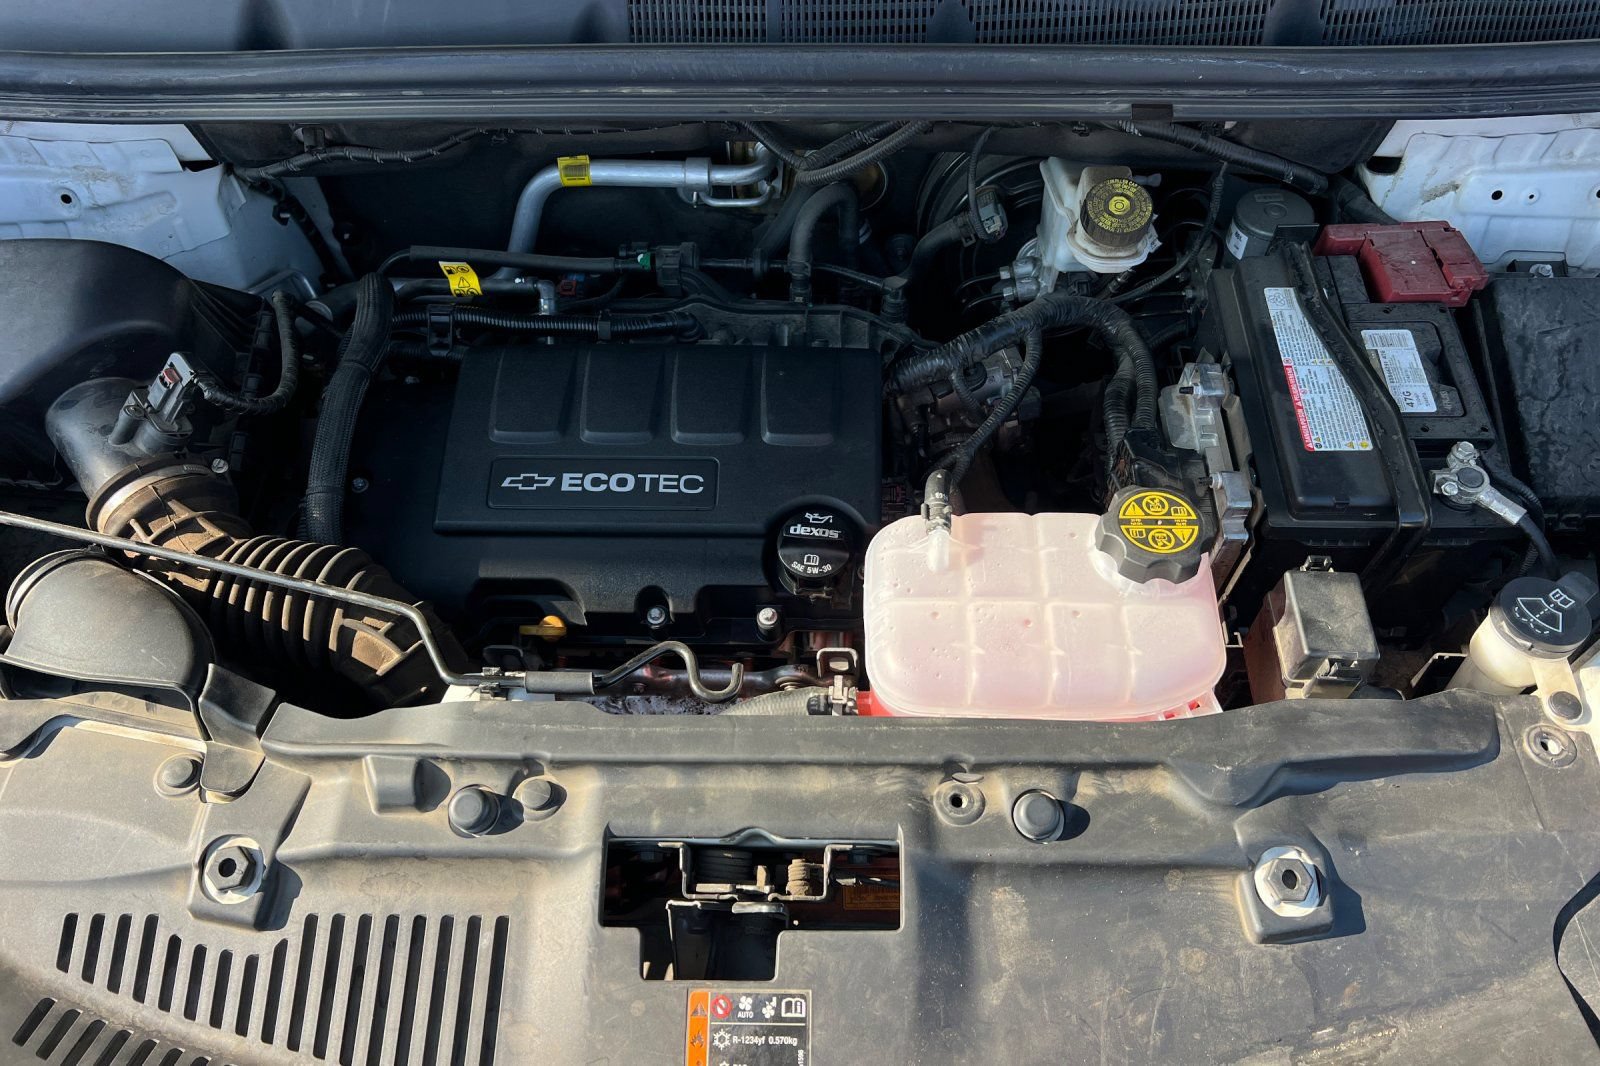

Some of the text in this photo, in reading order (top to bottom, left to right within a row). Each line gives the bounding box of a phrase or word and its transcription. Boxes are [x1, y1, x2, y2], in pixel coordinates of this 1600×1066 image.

[1402, 391, 1415, 408] 47G
[560, 472, 705, 494] ECOTEC
[789, 523, 842, 539] dexos
[791, 561, 832, 574] SAE 5W-30
[737, 1011, 754, 1019] AUTO
[732, 1036, 798, 1047] R-1234yf 0.570kg
